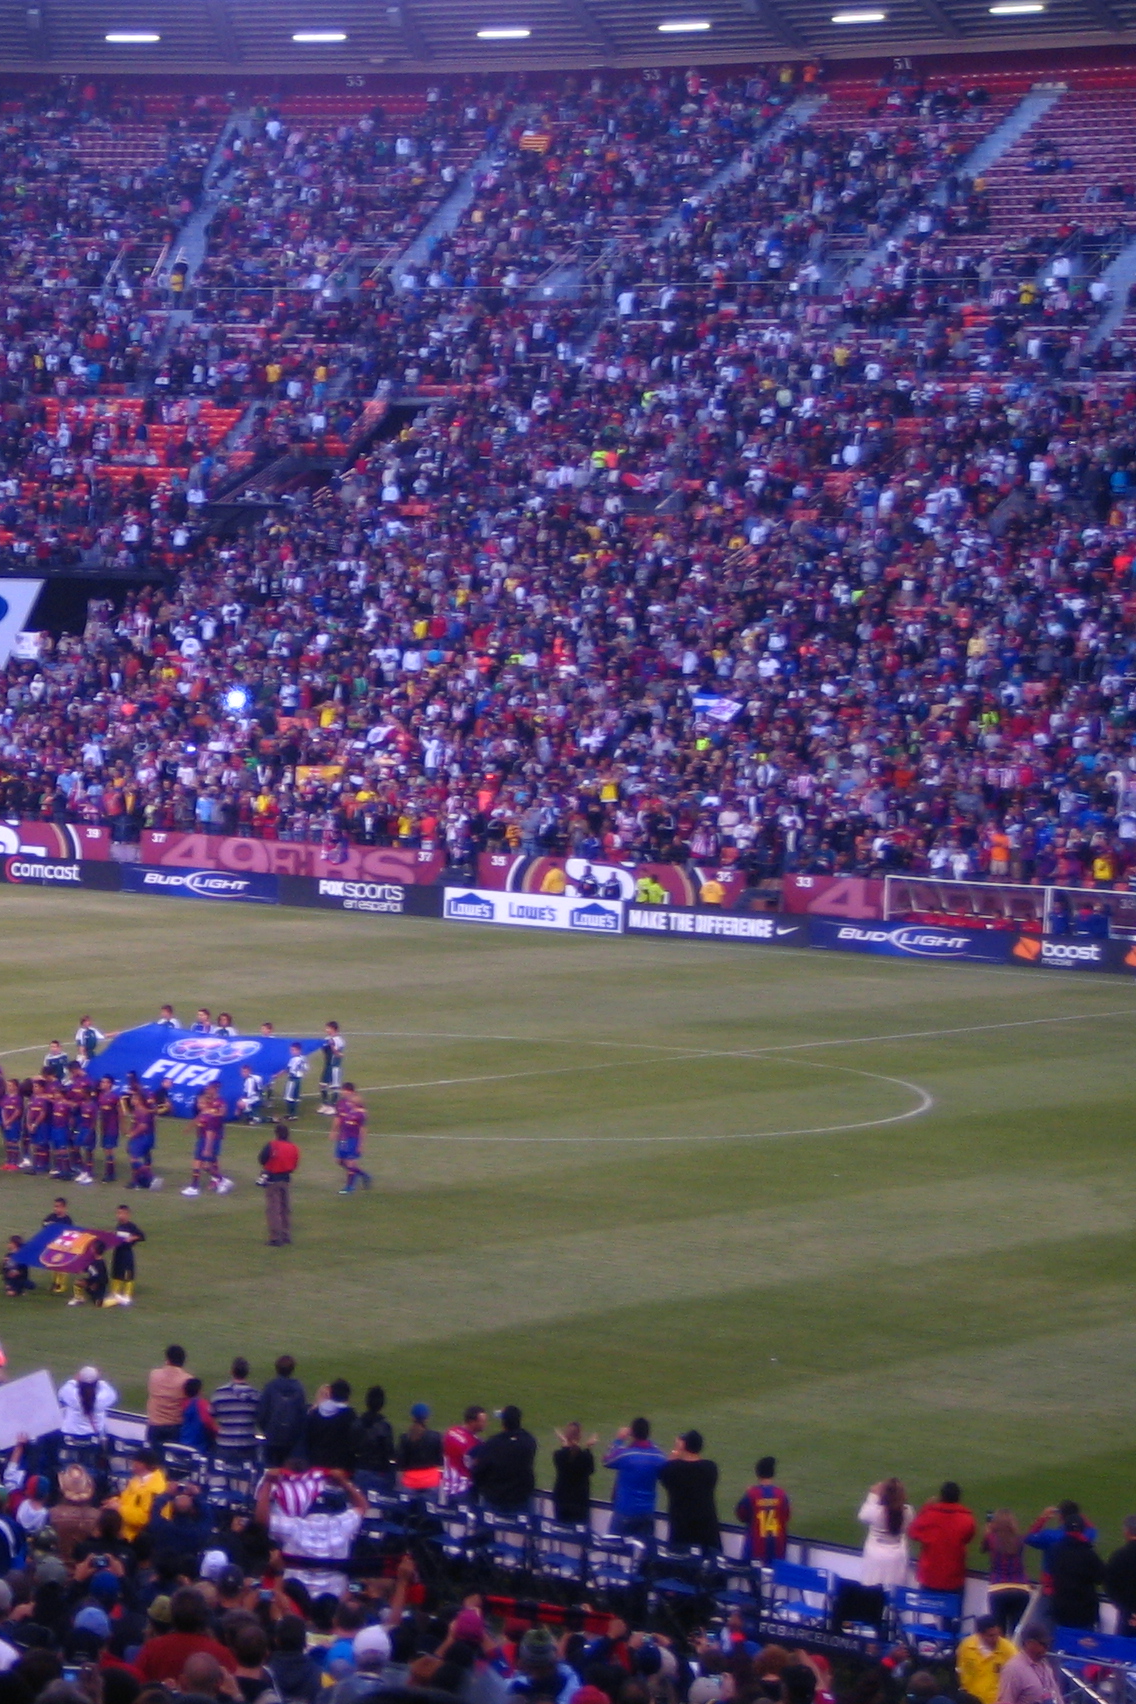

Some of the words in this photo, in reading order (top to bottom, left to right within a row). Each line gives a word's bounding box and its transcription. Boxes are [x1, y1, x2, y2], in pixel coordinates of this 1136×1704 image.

[143, 872, 185, 886] BUD
[192, 876, 250, 890] LIGHT
[795, 876, 813, 888] 33
[450, 902, 491, 919] LOWE'S
[509, 904, 558, 922] LOWE'S
[572, 912, 617, 929] LOWE'S
[629, 909, 668, 930] MAKE
[669, 912, 694, 932] THE
[695, 914, 774, 938] DIFFERENCE
[838, 927, 886, 942] BUD
[900, 932, 971, 948] LIGHT
[1041, 940, 1102, 961] boost
[142, 1058, 224, 1087] FIFA
[757, 1509, 781, 1538] 14
